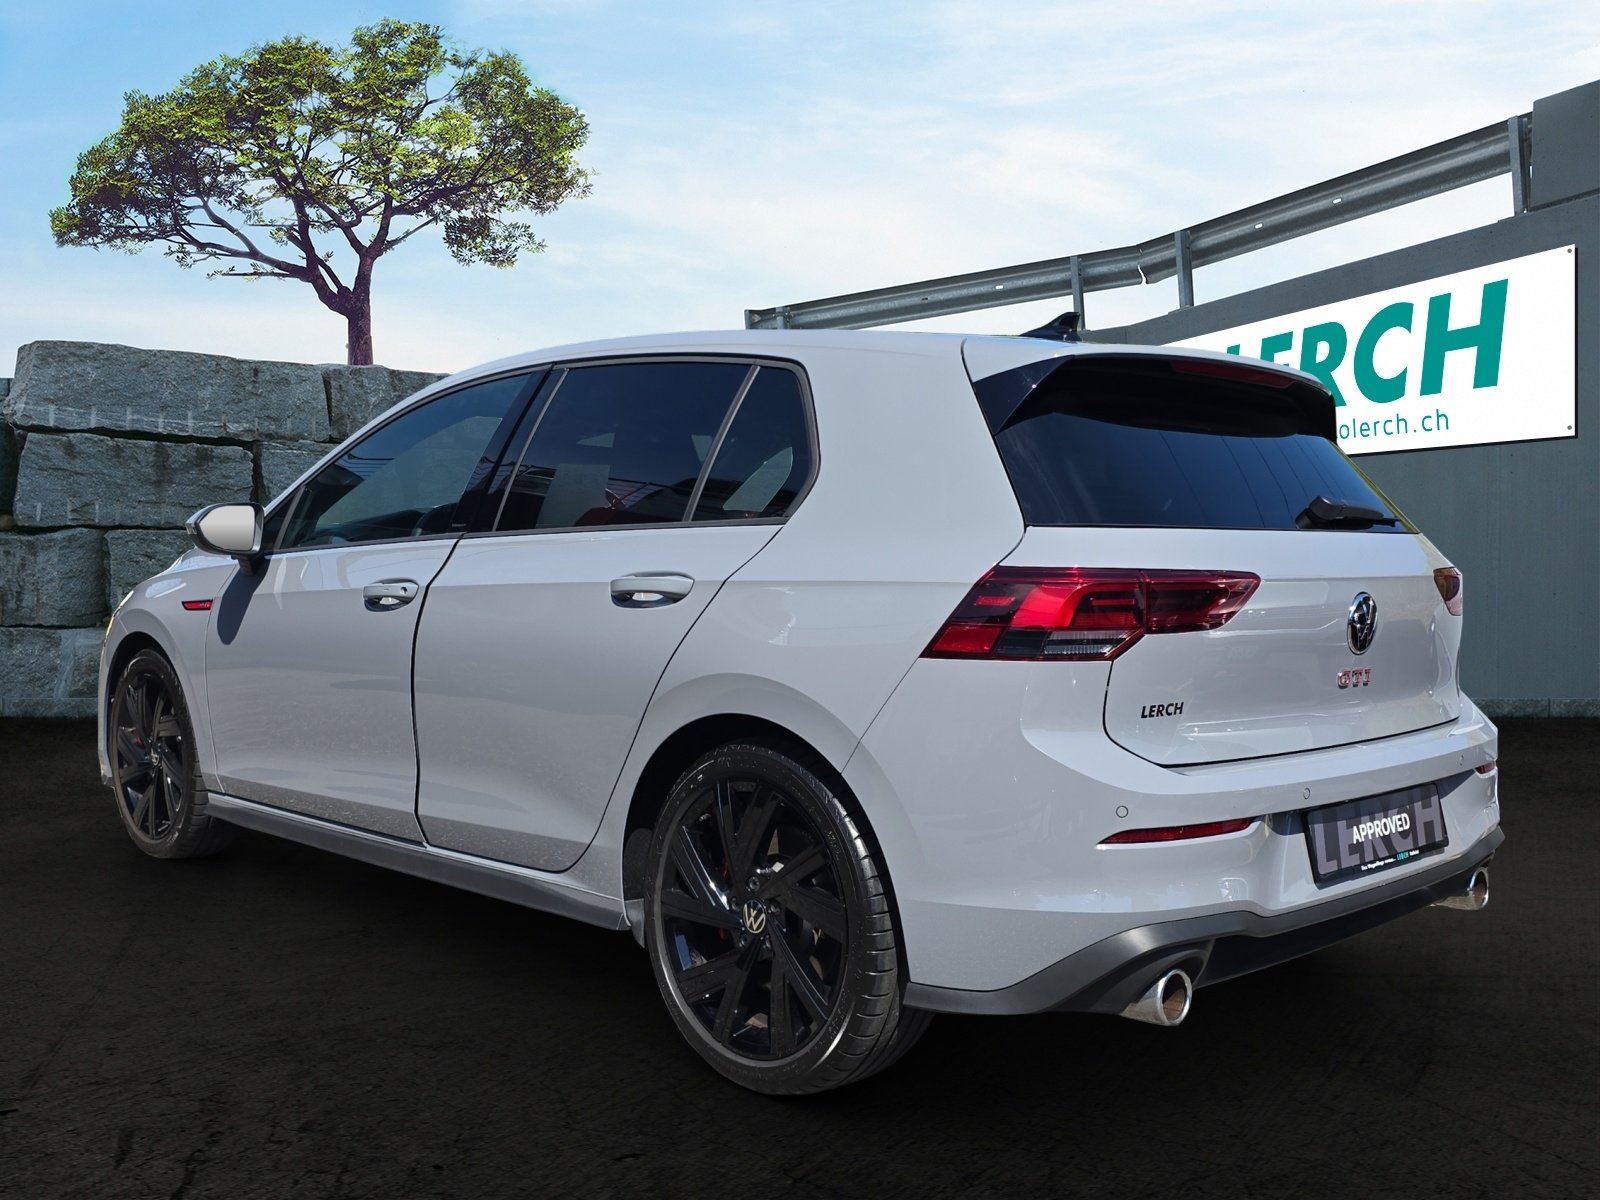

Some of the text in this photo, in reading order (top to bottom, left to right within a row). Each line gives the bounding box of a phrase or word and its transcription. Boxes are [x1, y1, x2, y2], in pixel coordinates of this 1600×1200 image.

[1227, 278, 1509, 407] RCH
[1337, 408, 1449, 439] olerch.ch
[1337, 668, 1372, 688] GTI
[1141, 701, 1184, 718] LERCH
[1352, 812, 1411, 845] APPROVED
